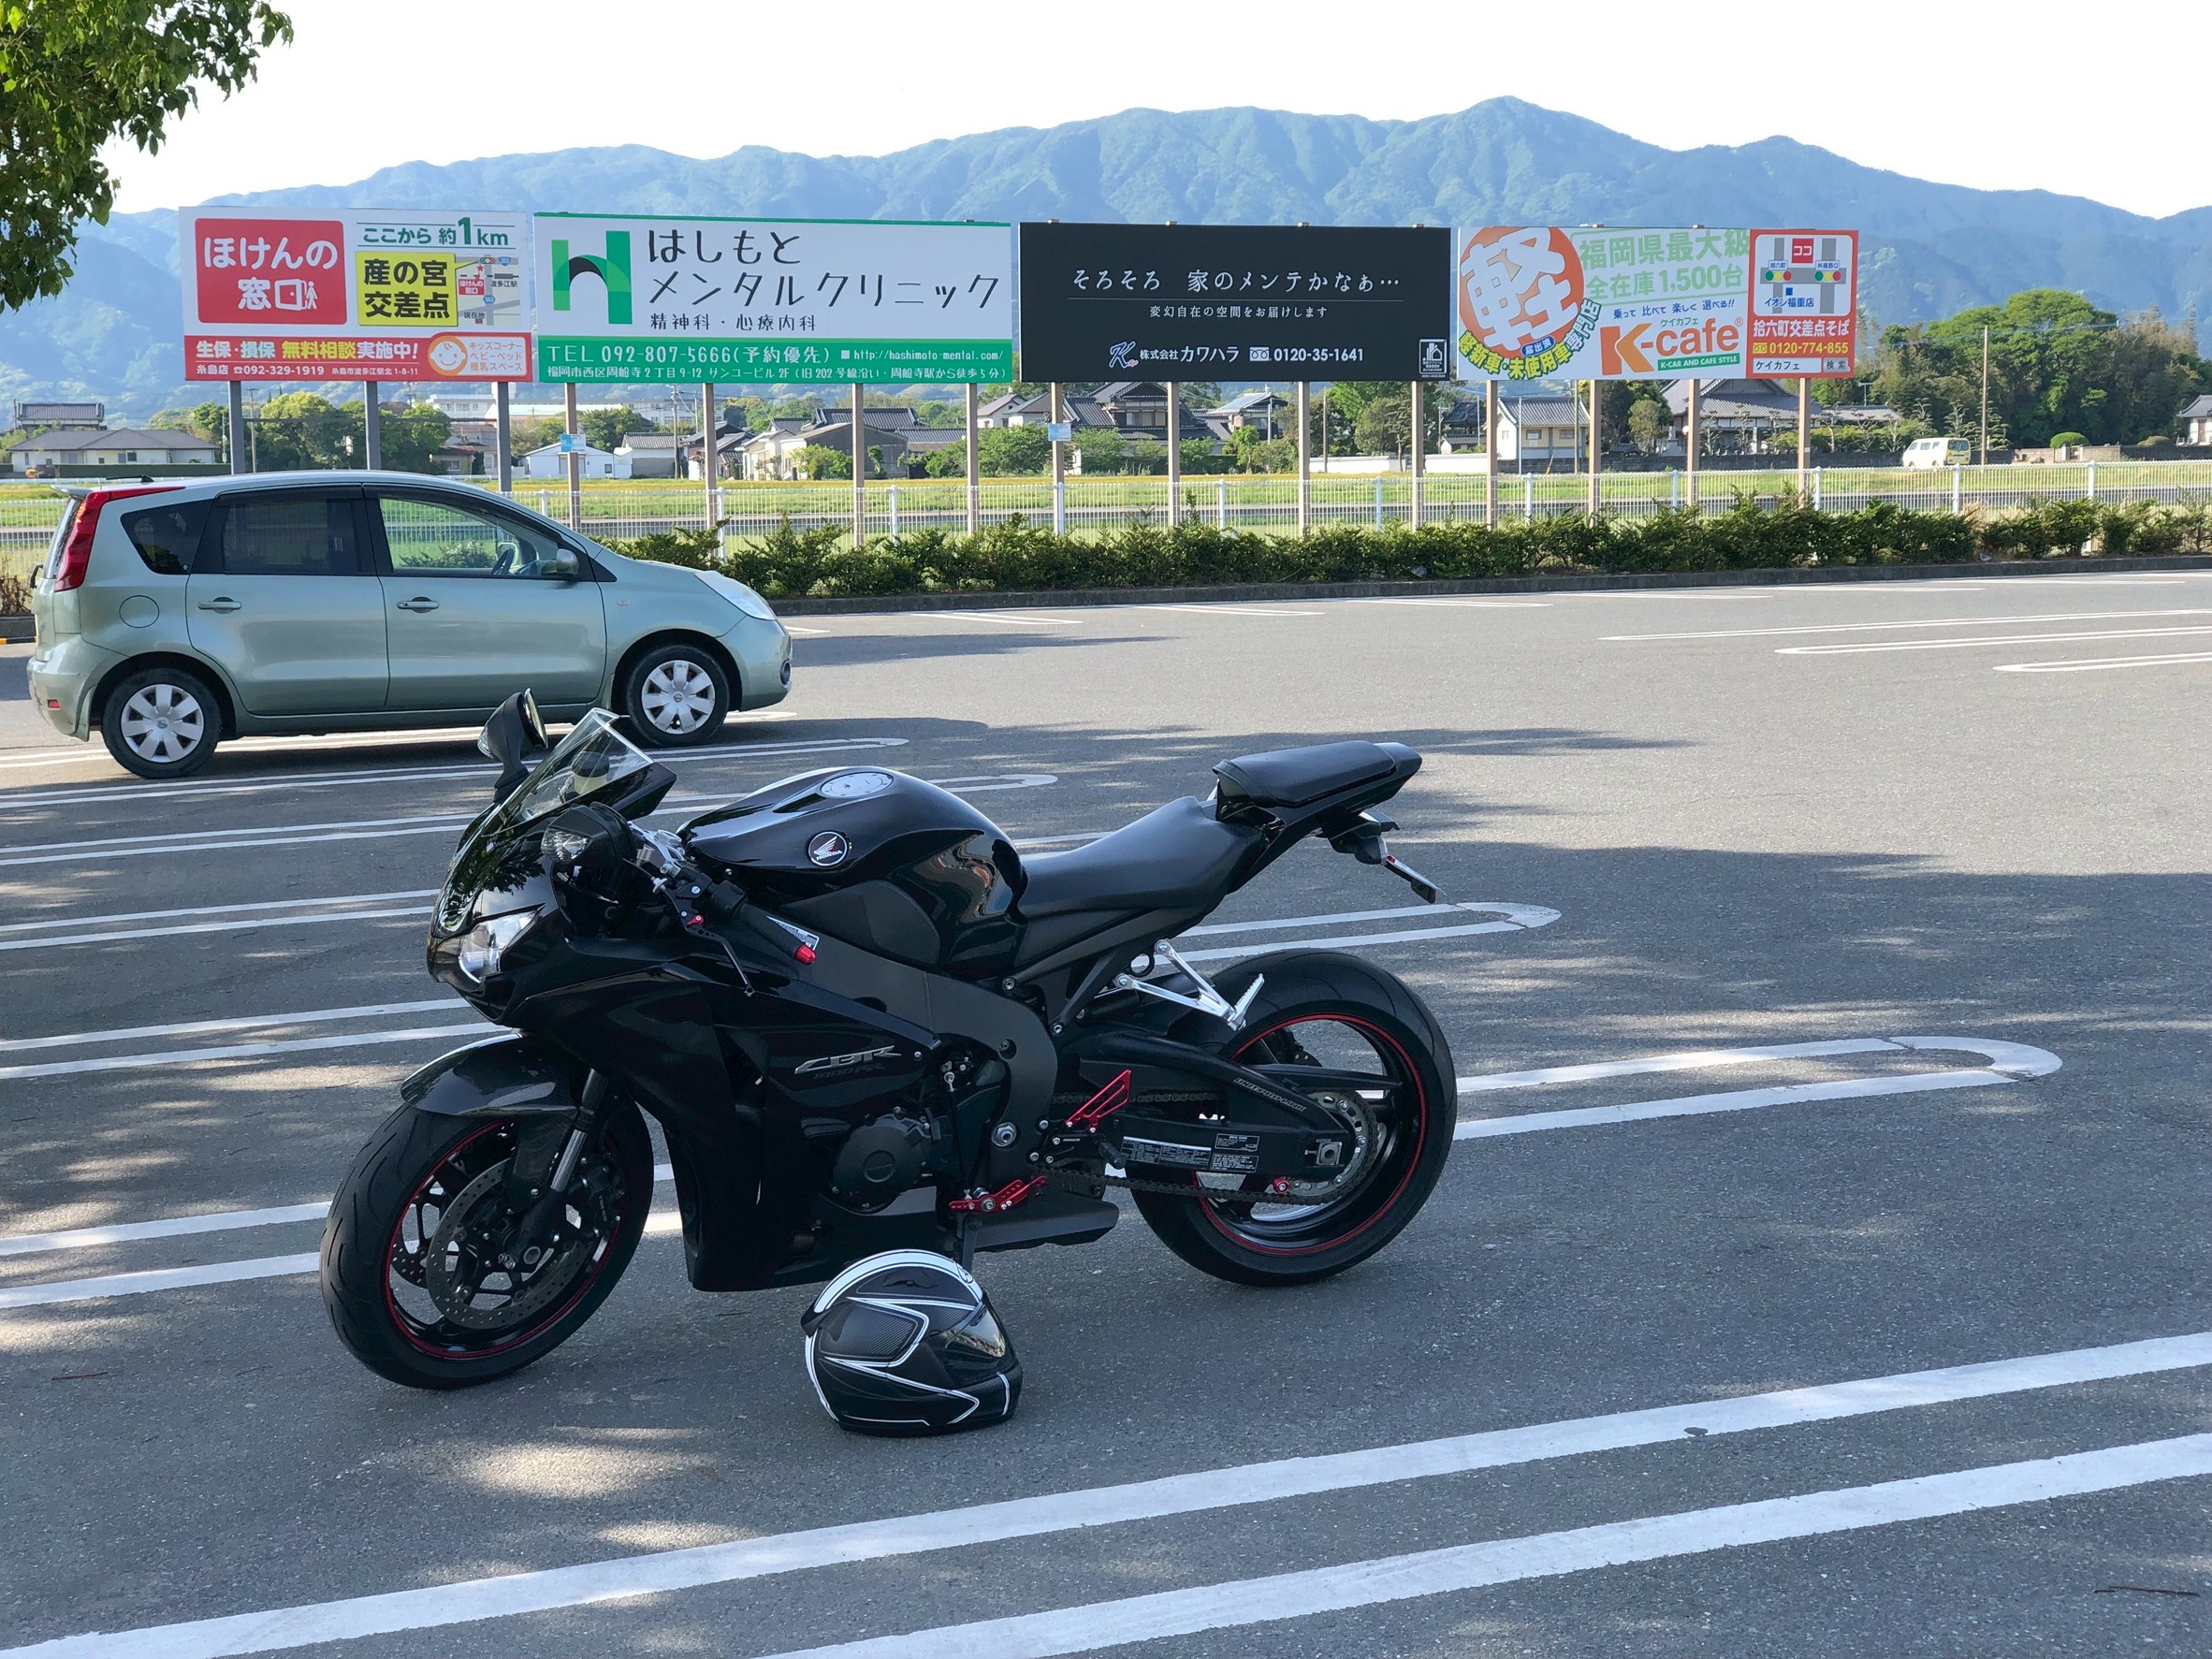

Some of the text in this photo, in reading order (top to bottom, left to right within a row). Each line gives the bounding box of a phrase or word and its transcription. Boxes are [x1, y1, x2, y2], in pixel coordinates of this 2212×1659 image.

[363, 217, 509, 247] ここから 約1km
[203, 236, 339, 269] ほけんの
[648, 228, 802, 265] はしもと
[1579, 229, 1750, 270] 福岡県最大級
[1793, 245, 1812, 256] ココ
[363, 258, 448, 286] 産の宮
[1072, 268, 1162, 292] そろそろ
[1586, 263, 1743, 300] 全在庫1,500台
[238, 278, 304, 311] 窓口
[648, 269, 1000, 310] メンタルクリニック
[364, 291, 450, 320] 交差点
[1149, 305, 1329, 319] 変幻自在の空間をお届けします
[1613, 309, 1637, 320] 乗って
[1642, 305, 1666, 317] 比べて
[1672, 302, 1697, 314] 楽しく
[1764, 298, 1815, 308] イオン福重店
[649, 313, 817, 332] 精神科・心療内科
[1660, 316, 1699, 327] ケイカフェ
[1753, 319, 1851, 338] 拾六町交差点そば
[196, 341, 419, 361] 生保・損保 無料相談実施中!
[469, 342, 523, 351] キッズコーナー
[546, 345, 594, 363] TEL
[853, 349, 1004, 361] http://hashimoto-mental.com/
[1273, 347, 1364, 362] 0120-35-1641
[1600, 317, 1739, 375] K-cafe
[1769, 342, 1849, 355] 0120-774-855
[196, 364, 229, 375] 糸島店
[243, 365, 325, 375] 092-329-1919
[470, 362, 523, 372] 授乳スペース
[1660, 355, 1738, 370] K-CAR AND CAFE STYLE
[1755, 359, 1847, 371] ケイカフェ 検索
[794, 1045, 902, 1074] CBR
